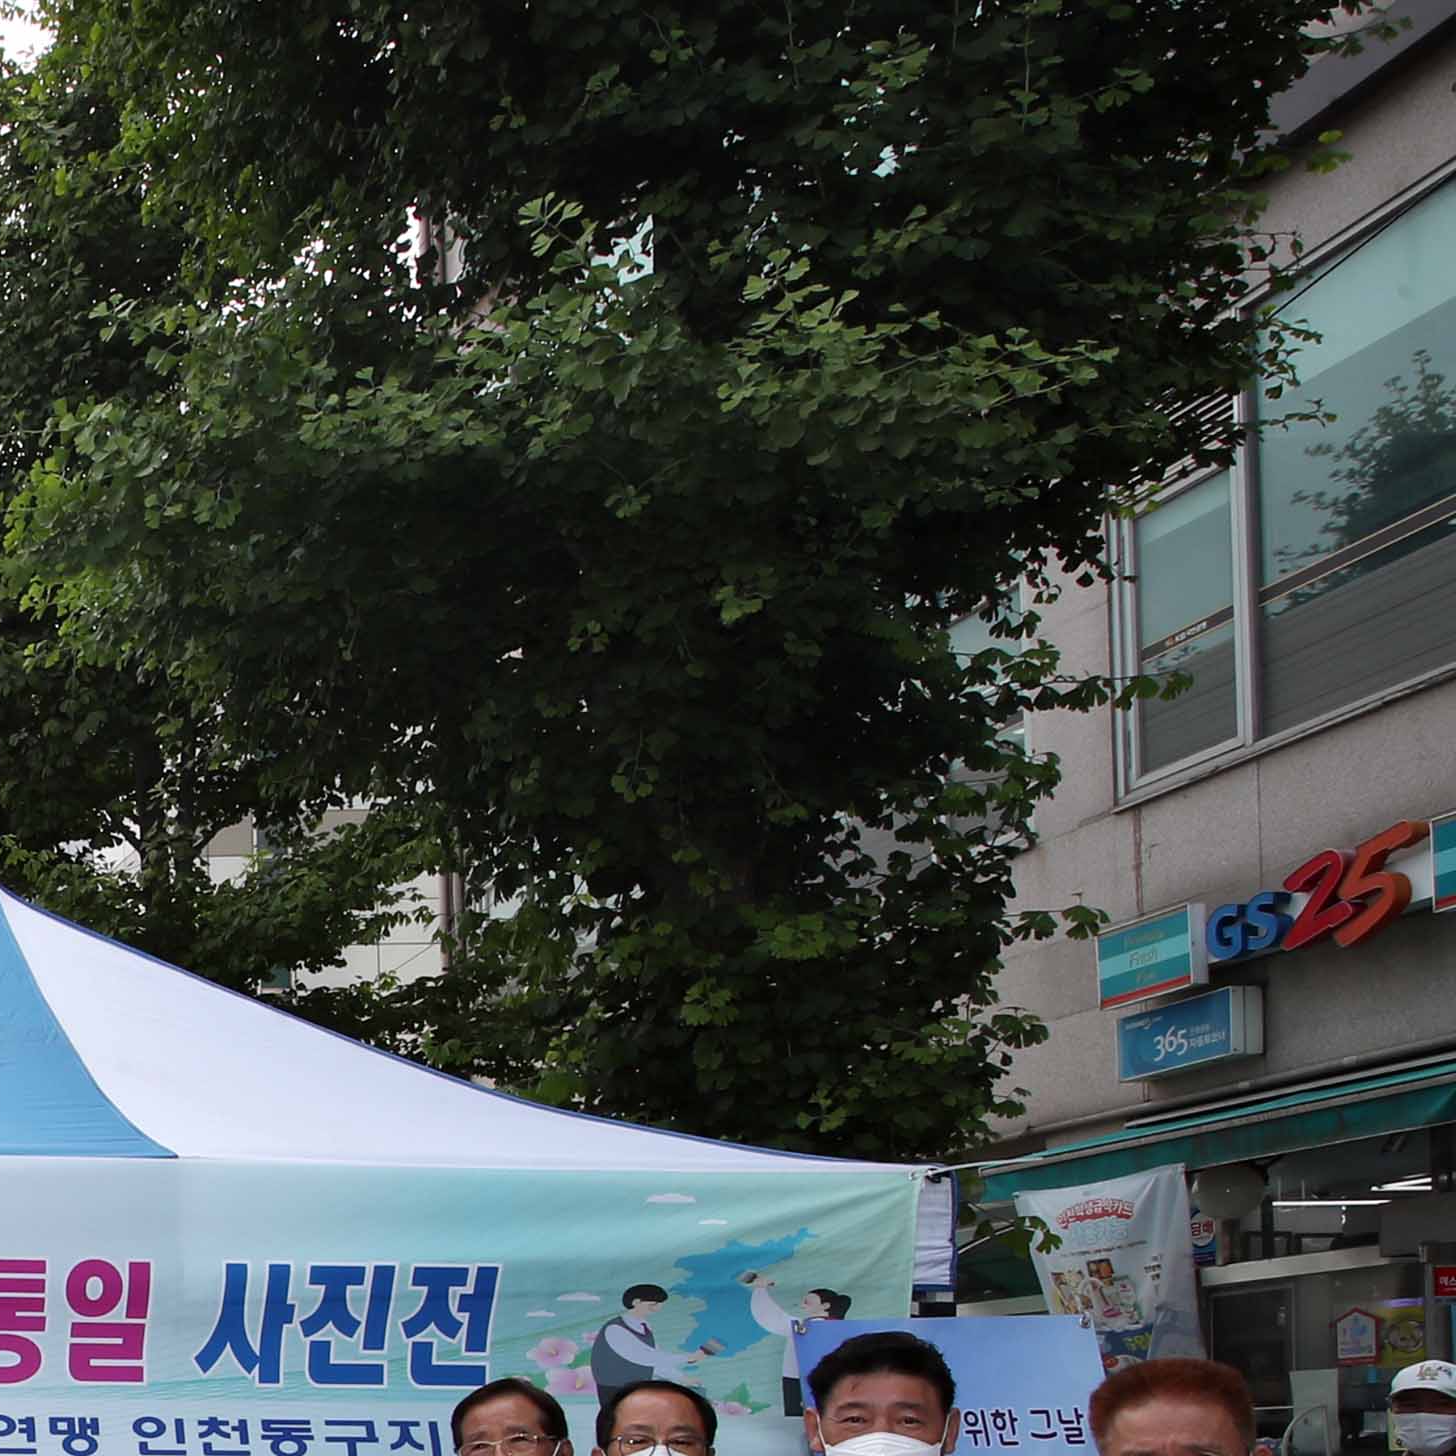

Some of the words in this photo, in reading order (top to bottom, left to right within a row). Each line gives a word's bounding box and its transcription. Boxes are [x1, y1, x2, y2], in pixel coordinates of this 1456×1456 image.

[1206, 819, 1430, 960] GS25
[1153, 1024, 1188, 1063] 365
[193, 1261, 503, 1390] 사진전
[963, 1409, 1019, 1447] 위한
[1029, 1408, 1086, 1445] 그날
